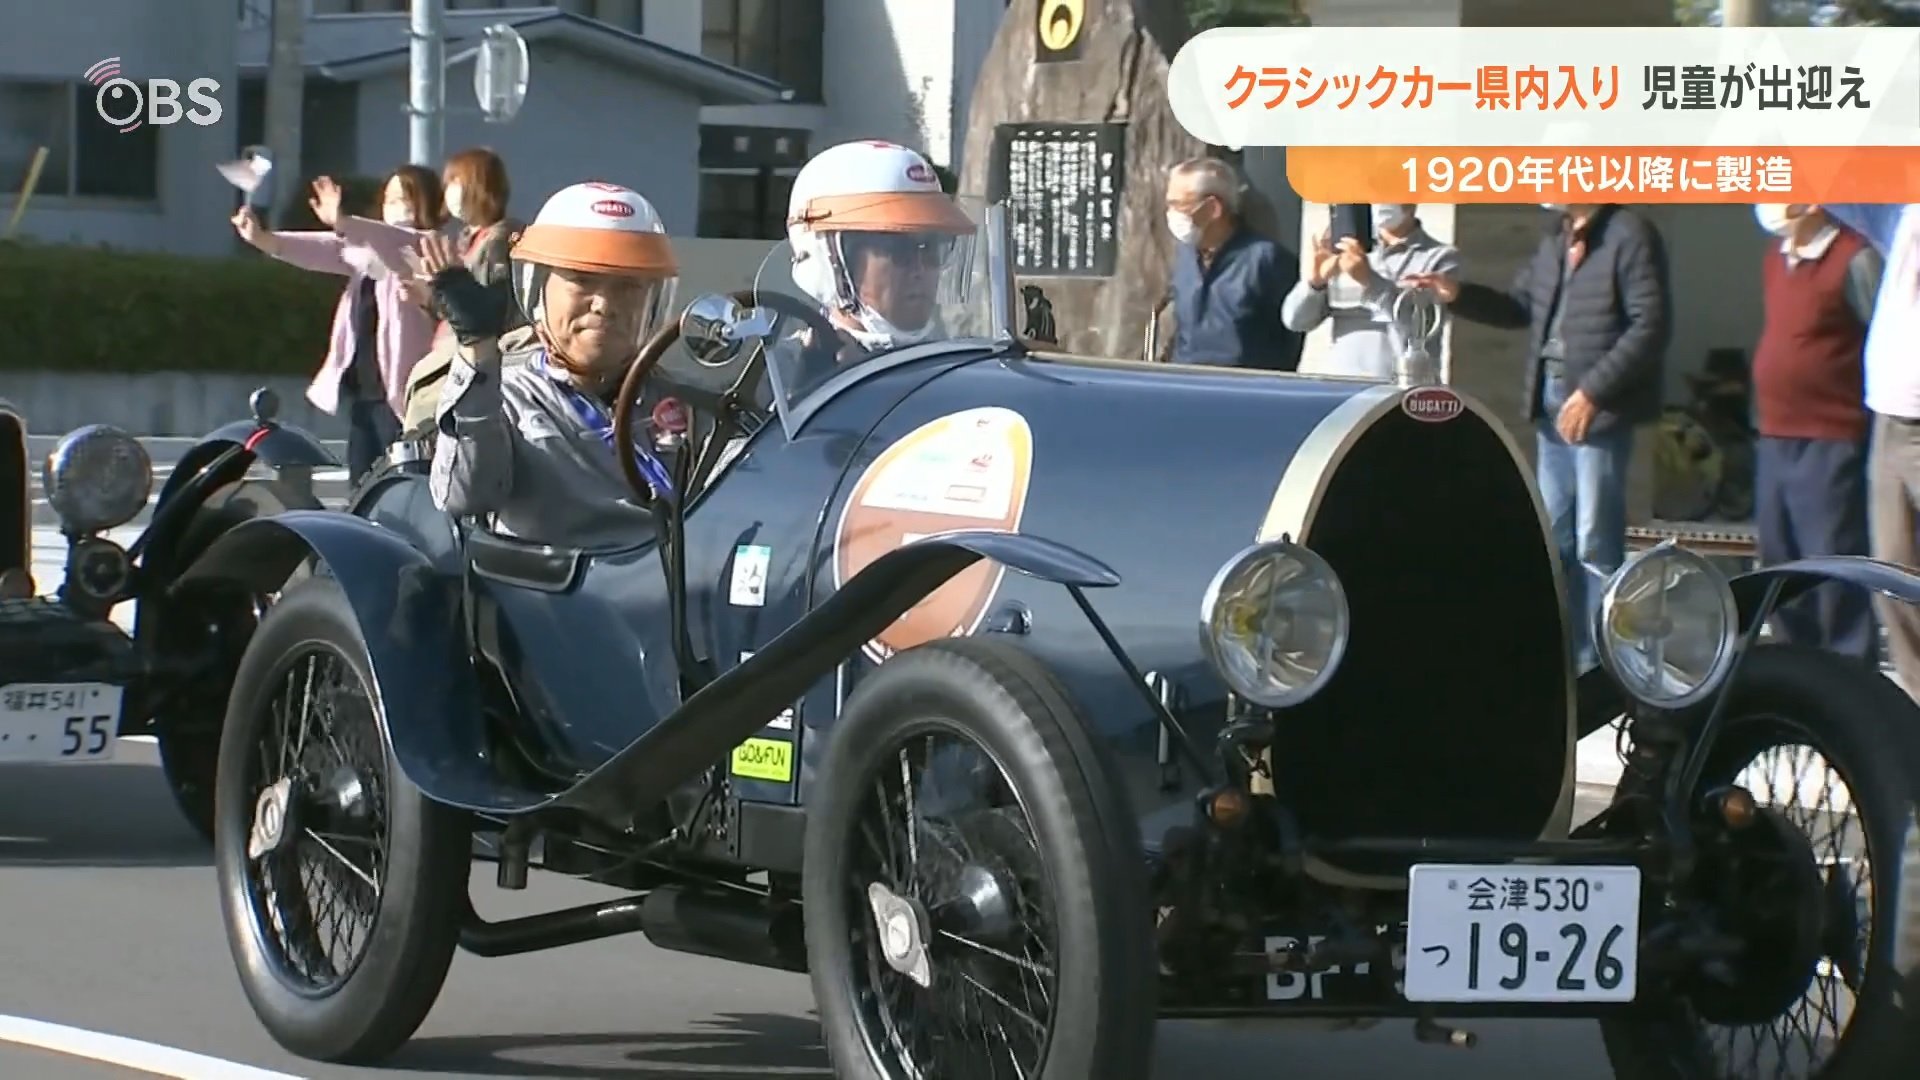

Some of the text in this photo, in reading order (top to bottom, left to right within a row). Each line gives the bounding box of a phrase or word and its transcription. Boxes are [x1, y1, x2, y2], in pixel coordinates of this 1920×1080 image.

[1409, 399, 1459, 412] BUGATTI
[1467, 877, 1590, 912] 会津530
[1467, 922, 1624, 991] 19-26
